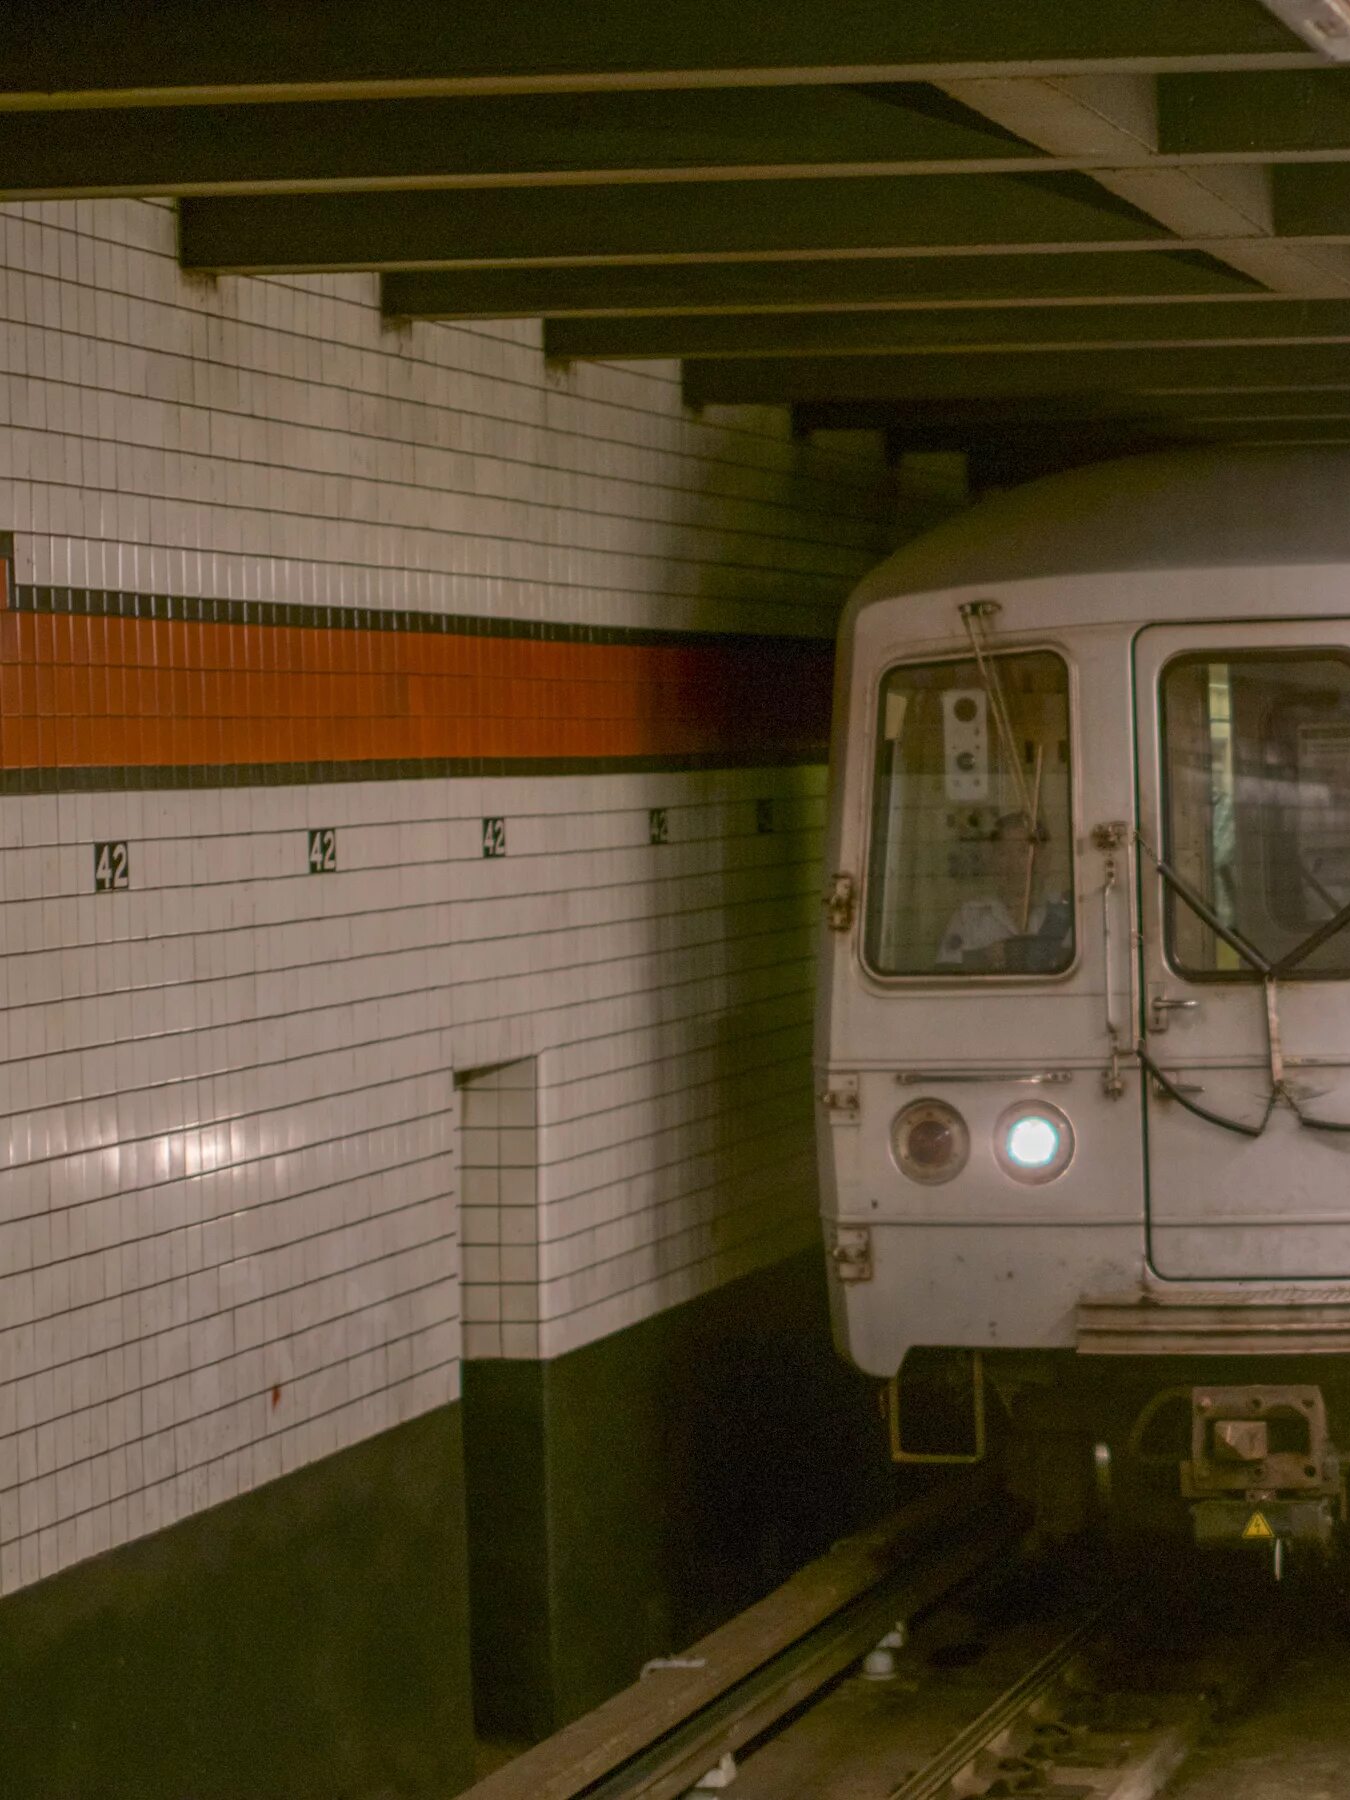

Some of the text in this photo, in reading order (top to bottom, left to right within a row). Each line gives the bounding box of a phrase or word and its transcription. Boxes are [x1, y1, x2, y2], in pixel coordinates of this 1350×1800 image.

[310, 831, 336, 871] 42
[484, 819, 505, 855] 42
[96, 843, 129, 889] 42
